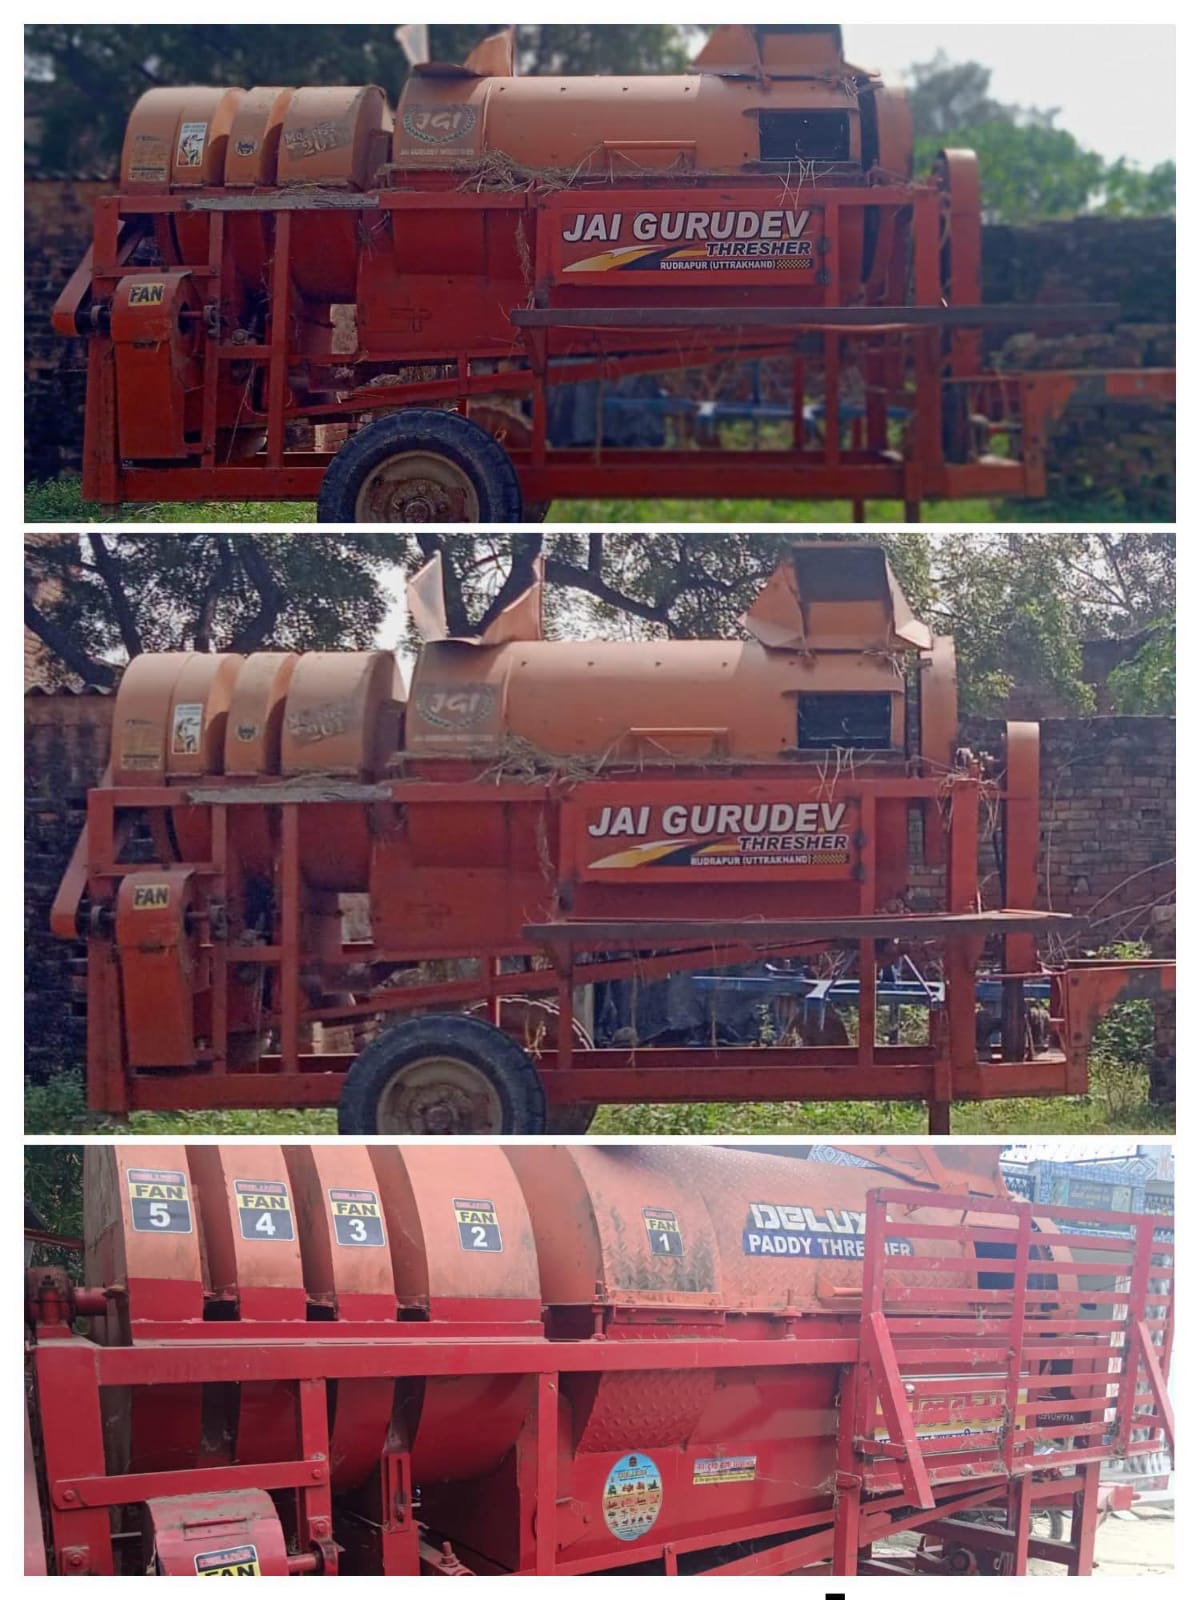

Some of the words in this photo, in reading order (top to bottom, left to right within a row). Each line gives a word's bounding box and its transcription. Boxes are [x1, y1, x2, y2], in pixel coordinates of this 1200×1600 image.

[562, 213, 623, 242] JAI
[633, 210, 810, 241] GURUDEV
[705, 241, 812, 256] THRESHER
[660, 260, 708, 270] RUDRAPUR
[710, 260, 776, 271] (UTTRAKHAND)
[129, 286, 164, 303] FAN
[588, 806, 650, 836] JAI
[662, 803, 846, 834] GURUDEV
[737, 835, 848, 850] THRESHER
[134, 888, 167, 905] FAN
[135, 1184, 184, 1199] FAN
[242, 1195, 286, 1209] FAN
[336, 1203, 377, 1216] FAN
[149, 1202, 171, 1228] 5
[460, 1211, 495, 1224] FAN
[750, 1203, 891, 1234] DELUX
[255, 1212, 276, 1236] 4
[348, 1218, 368, 1242] 3
[649, 1219, 676, 1232] FAN
[470, 1226, 488, 1248] 2
[659, 1232, 671, 1253] 1
[748, 1234, 812, 1256] PADDY
[817, 1238, 912, 1257] THREER
[205, 1564, 255, 1576] AN
